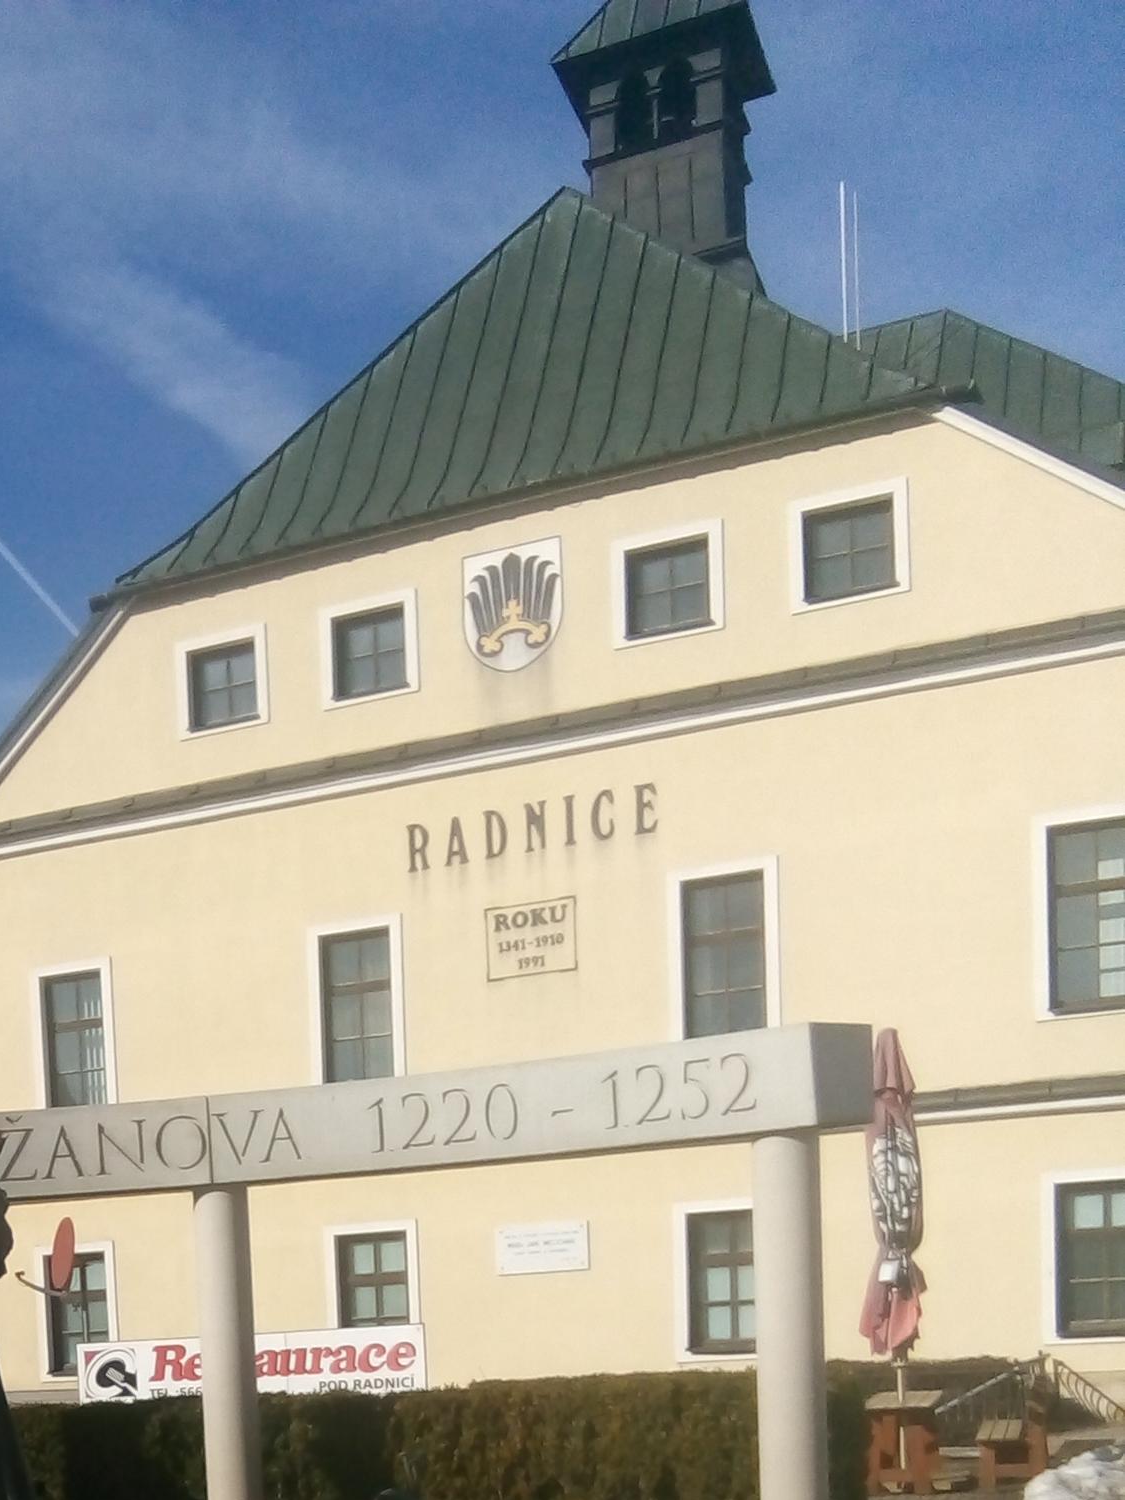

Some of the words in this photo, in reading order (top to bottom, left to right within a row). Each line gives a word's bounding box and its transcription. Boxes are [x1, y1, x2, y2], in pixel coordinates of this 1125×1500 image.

[406, 783, 658, 873] RADNICE
[493, 904, 567, 932] ROKU
[366, 1083, 520, 1154] 1220
[600, 1053, 758, 1130] 1252
[148, 1341, 417, 1383] Reaurace
[319, 1379, 348, 1393] POD
[352, 1373, 416, 1391] RADNICÍ
